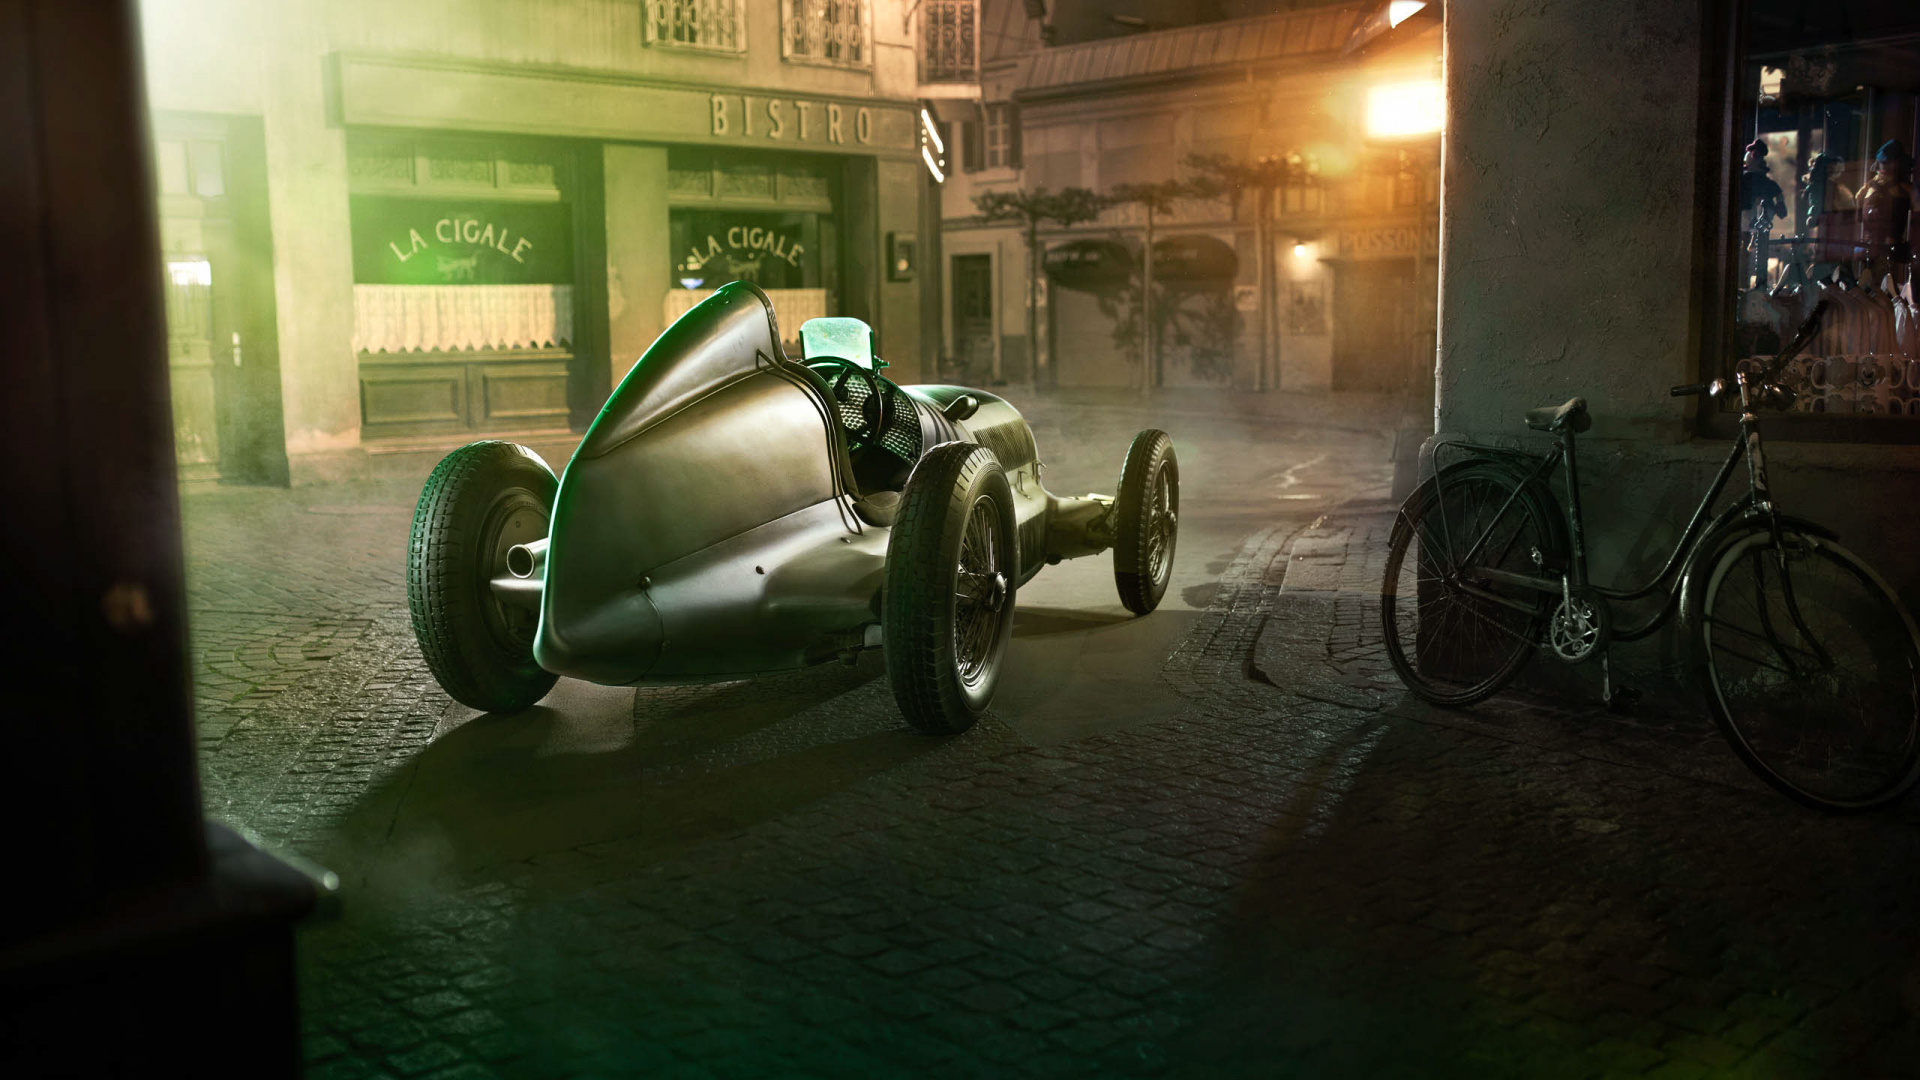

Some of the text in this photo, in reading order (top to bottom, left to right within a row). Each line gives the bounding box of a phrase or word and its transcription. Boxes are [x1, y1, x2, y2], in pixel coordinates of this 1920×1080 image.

[711, 93, 872, 145] BISTRO
[389, 218, 533, 264] LA CIGALE
[691, 226, 805, 267] LA CIGALE
